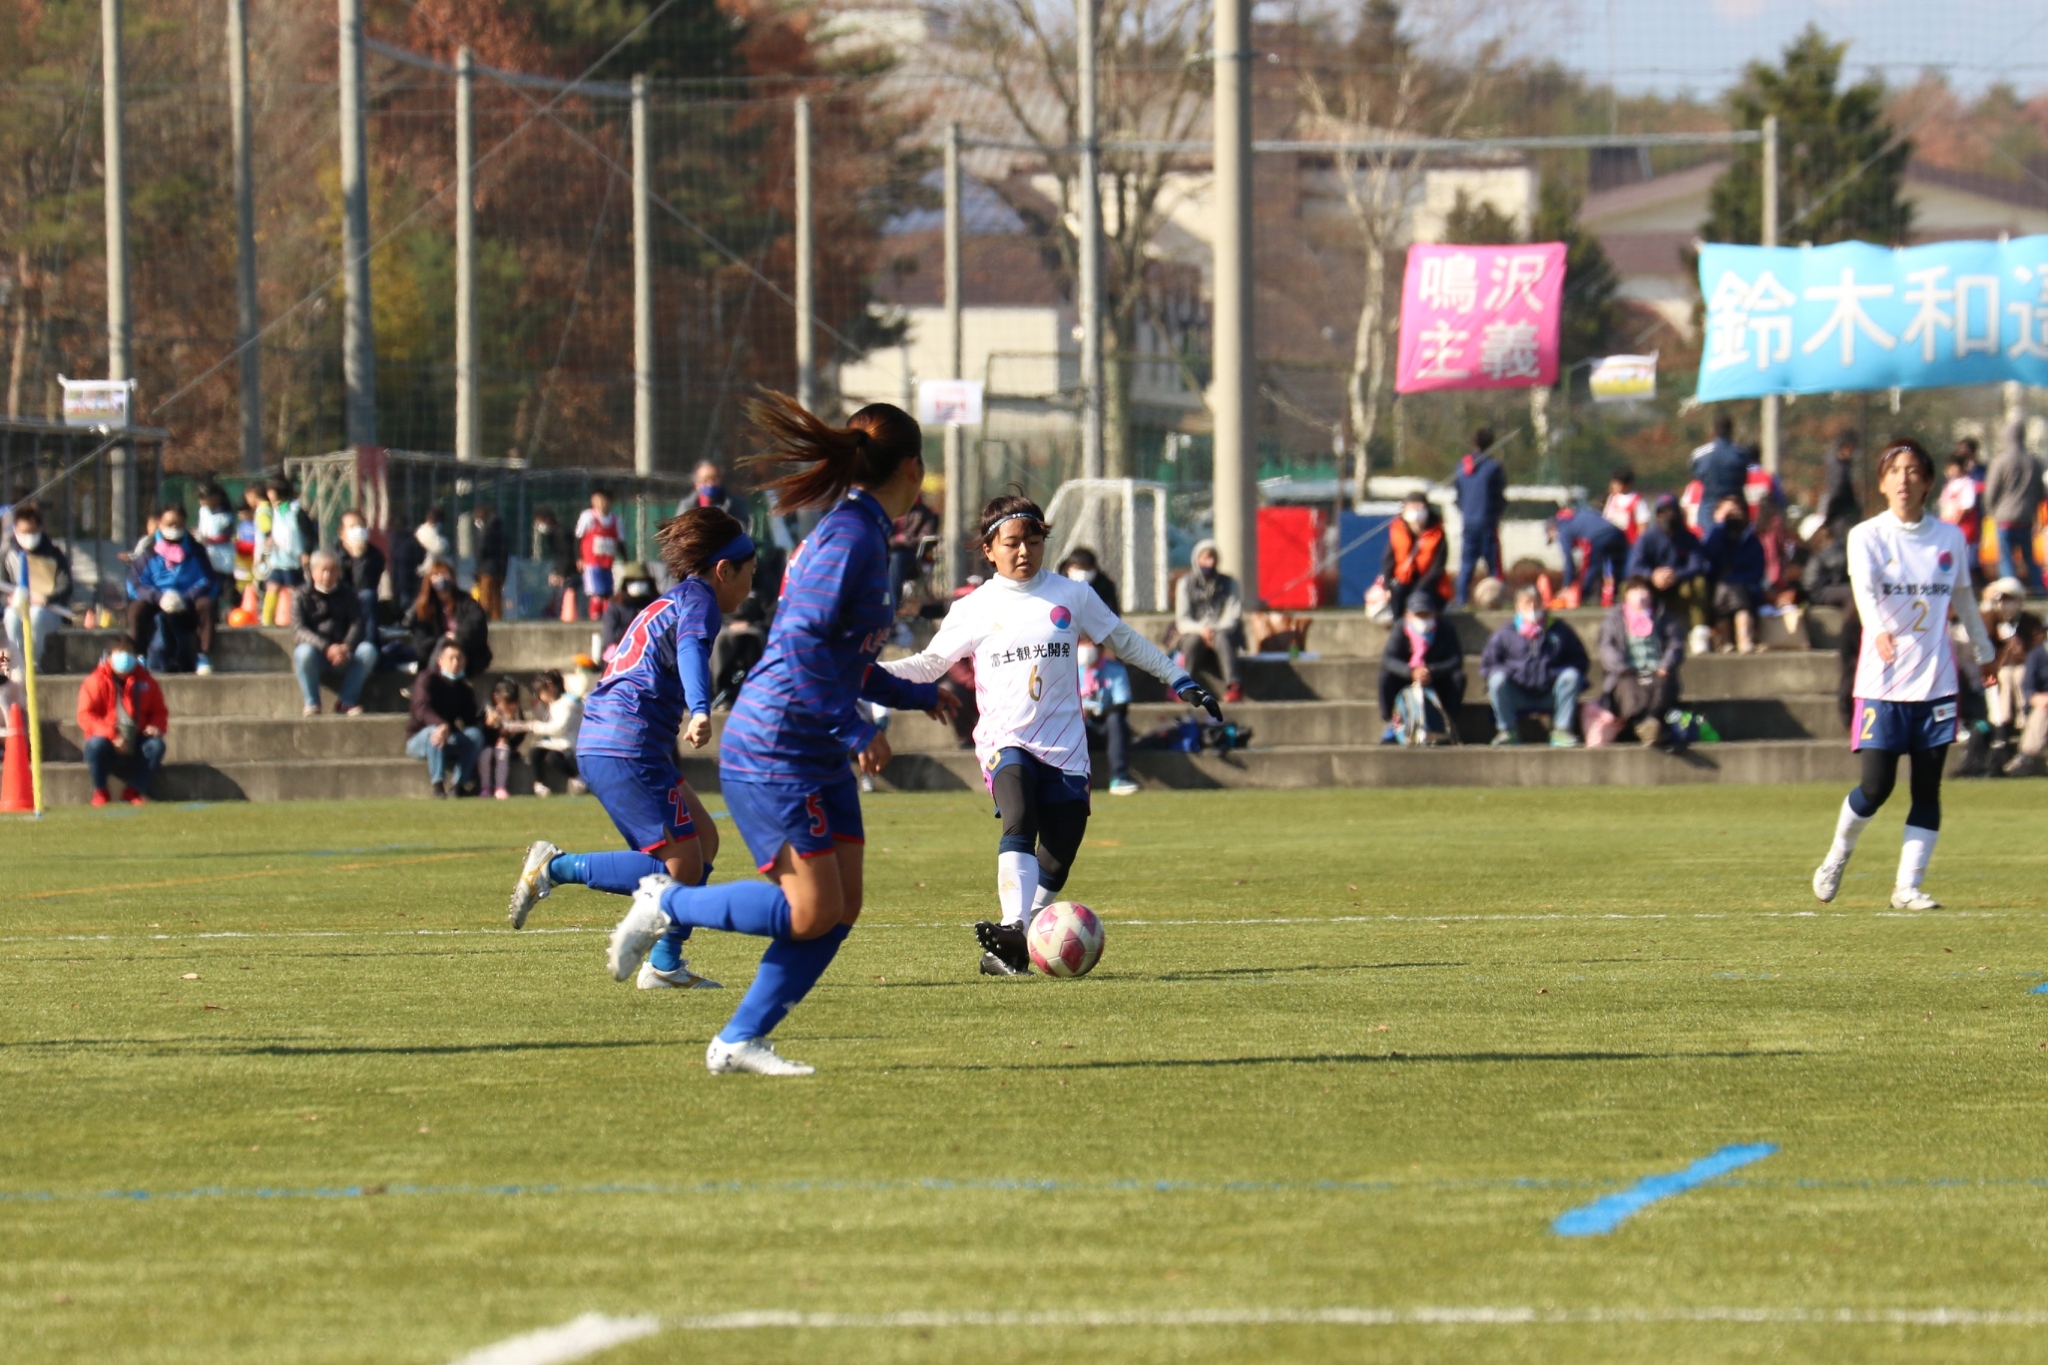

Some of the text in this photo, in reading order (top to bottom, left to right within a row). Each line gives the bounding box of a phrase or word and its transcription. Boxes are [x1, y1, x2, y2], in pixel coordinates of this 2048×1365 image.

[1418, 252, 1547, 315] 鳴沢
[1415, 319, 1541, 380] 主義
[1911, 600, 1930, 632] 2
[990, 642, 1071, 668] 富士観光開発
[1028, 664, 1043, 702] 6
[1860, 707, 1877, 740] 2
[668, 788, 693, 827] 2
[805, 794, 829, 837] 5
